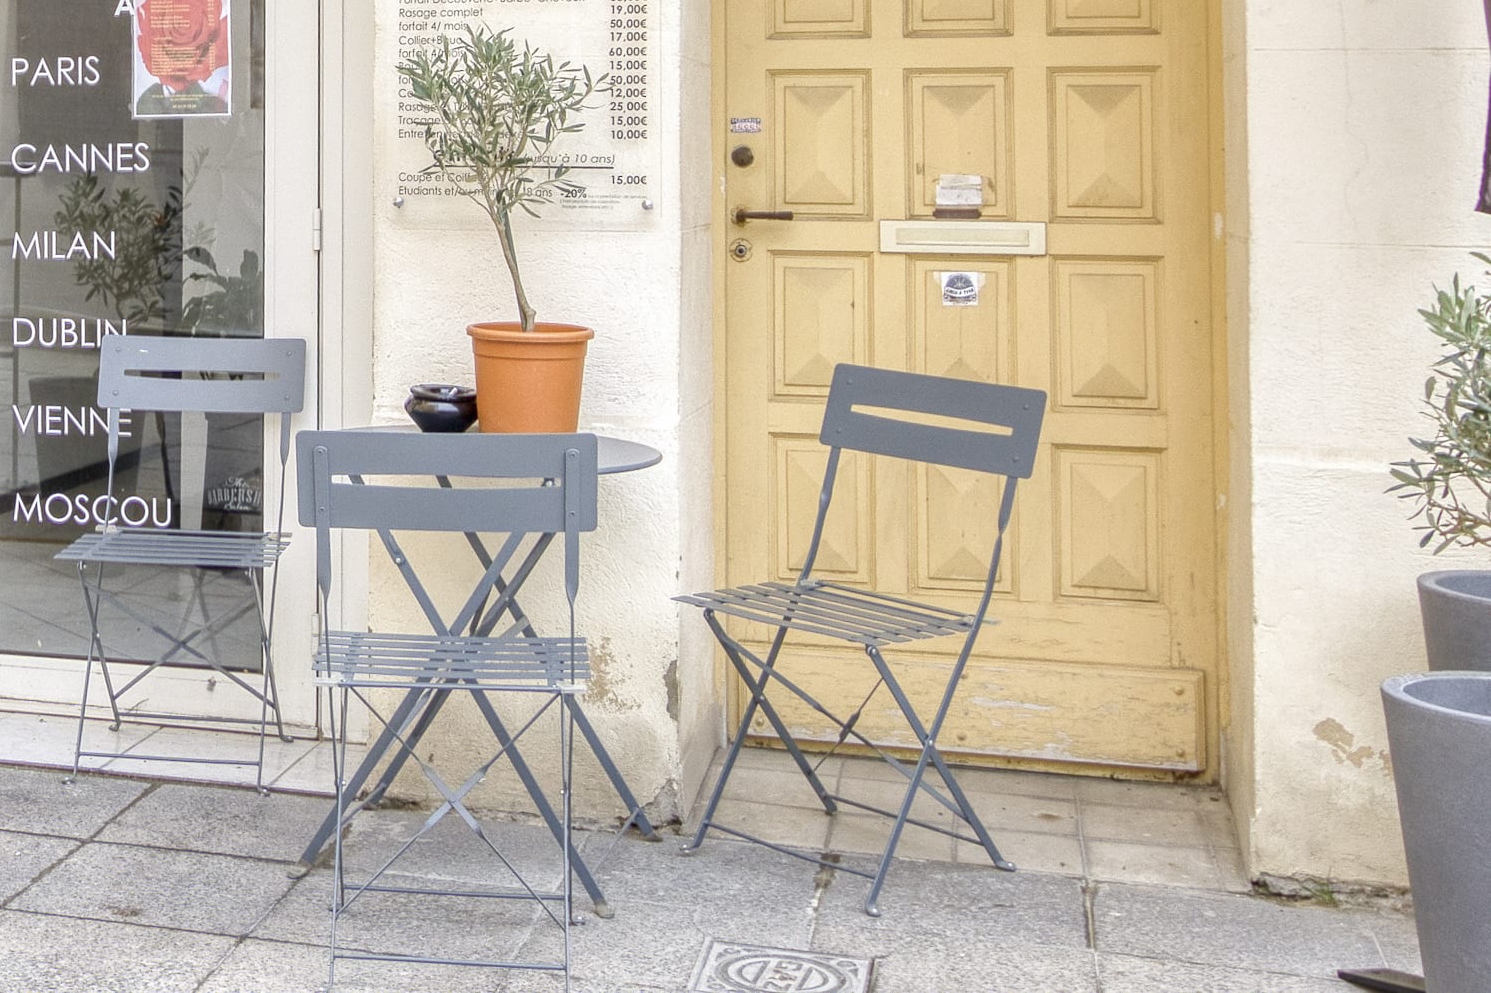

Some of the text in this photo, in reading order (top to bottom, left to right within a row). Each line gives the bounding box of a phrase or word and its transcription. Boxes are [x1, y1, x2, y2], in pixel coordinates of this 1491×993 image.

[399, 8, 483, 19] Rasage complet
[611, 5, 647, 15] 19,00€
[399, 21, 428, 31] forfait
[610, 19, 647, 29] 50,00€
[611, 32, 647, 43] 17,00€
[608, 47, 647, 57] 60,00€
[11, 56, 101, 86] PARIS
[610, 61, 647, 71] 15,00€
[609, 89, 646, 99] 12,00€
[610, 102, 647, 112] 25,00€
[610, 116, 647, 126] 15,00€
[610, 130, 647, 140] 10,00€
[11, 143, 150, 173] CANNES
[575, 154, 588, 163] 10
[591, 154, 615, 164] ans)
[399, 172, 445, 183] Coupe et
[611, 175, 647, 186] 15,00€
[399, 186, 442, 196] Etudiants
[535, 188, 553, 197] ans
[12, 230, 116, 261] MILAN
[12, 318, 127, 349] DUBLIN
[12, 405, 132, 437] VIENNE
[12, 493, 172, 527] MOSCOU
